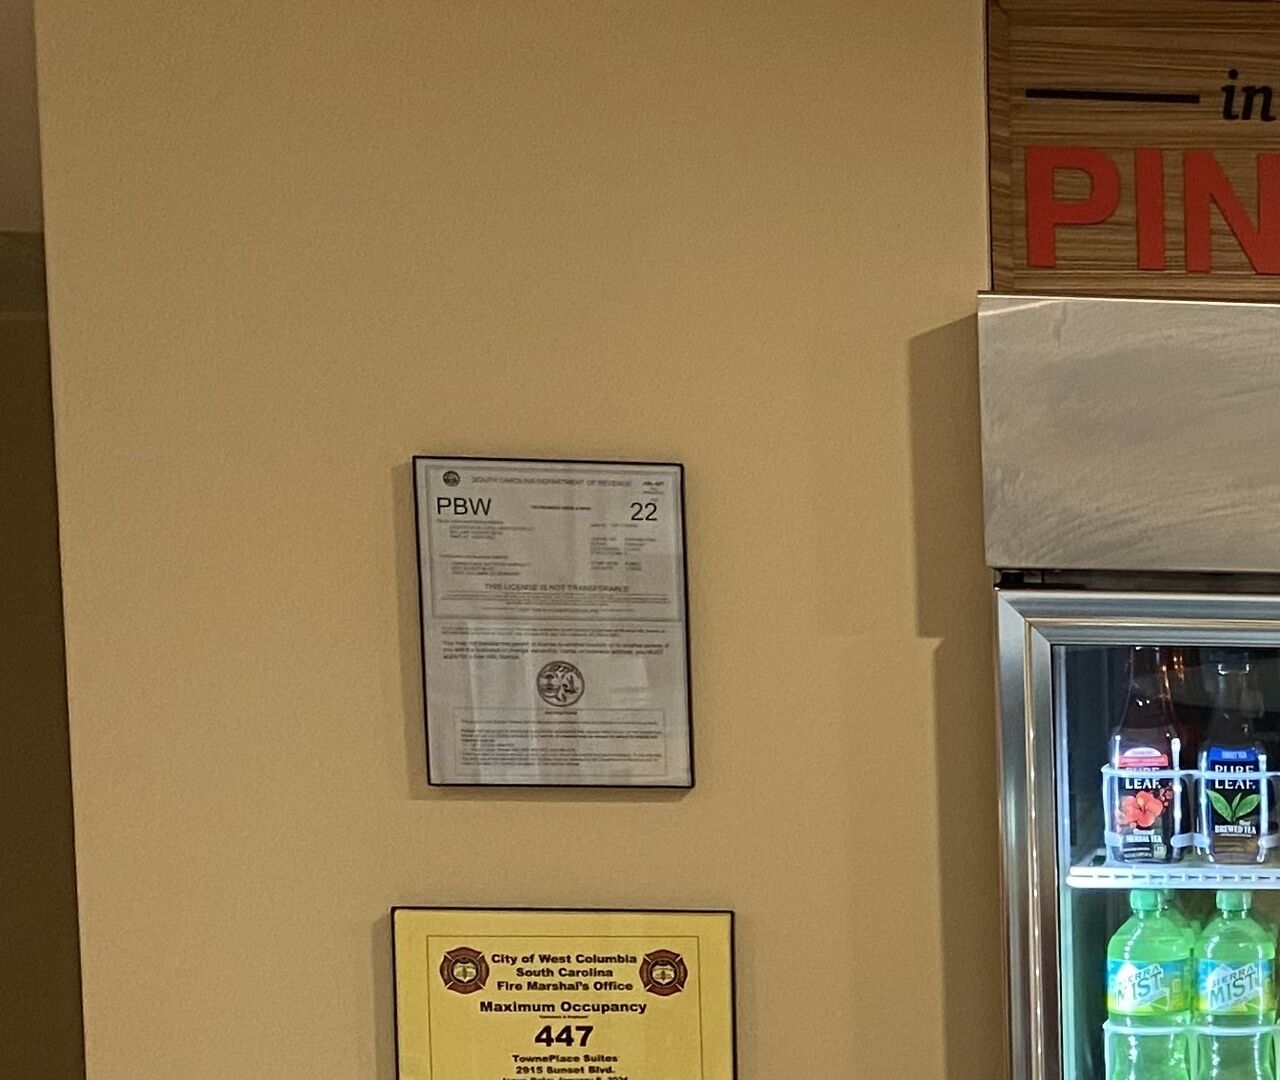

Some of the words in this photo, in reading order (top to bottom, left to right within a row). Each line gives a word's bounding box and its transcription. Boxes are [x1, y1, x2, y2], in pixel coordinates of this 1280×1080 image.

[1220, 69, 1276, 122] in
[436, 497, 491, 516] PBW
[630, 502, 658, 521] 22
[1214, 824, 1242, 834] BREWED
[1243, 826, 1257, 835] TEA
[491, 954, 518, 965] City
[522, 954, 534, 963] of
[538, 954, 571, 964] West
[575, 954, 637, 964] Columbia
[516, 967, 554, 977] South
[558, 967, 613, 977] Carolina
[1212, 963, 1256, 986] SIERRA
[497, 981, 524, 990] Fire
[527, 981, 589, 991] Marshal's
[593, 981, 633, 991] Office
[1210, 969, 1257, 1004] MIST
[480, 1001, 555, 1012] Maximum
[560, 1001, 647, 1014] Occupancy
[534, 1025, 593, 1047] 447
[512, 1054, 580, 1063] TownePlace
[583, 1054, 618, 1063] Suites
[547, 1066, 584, 1074] Sunset
[588, 1066, 615, 1074] Blvd.
